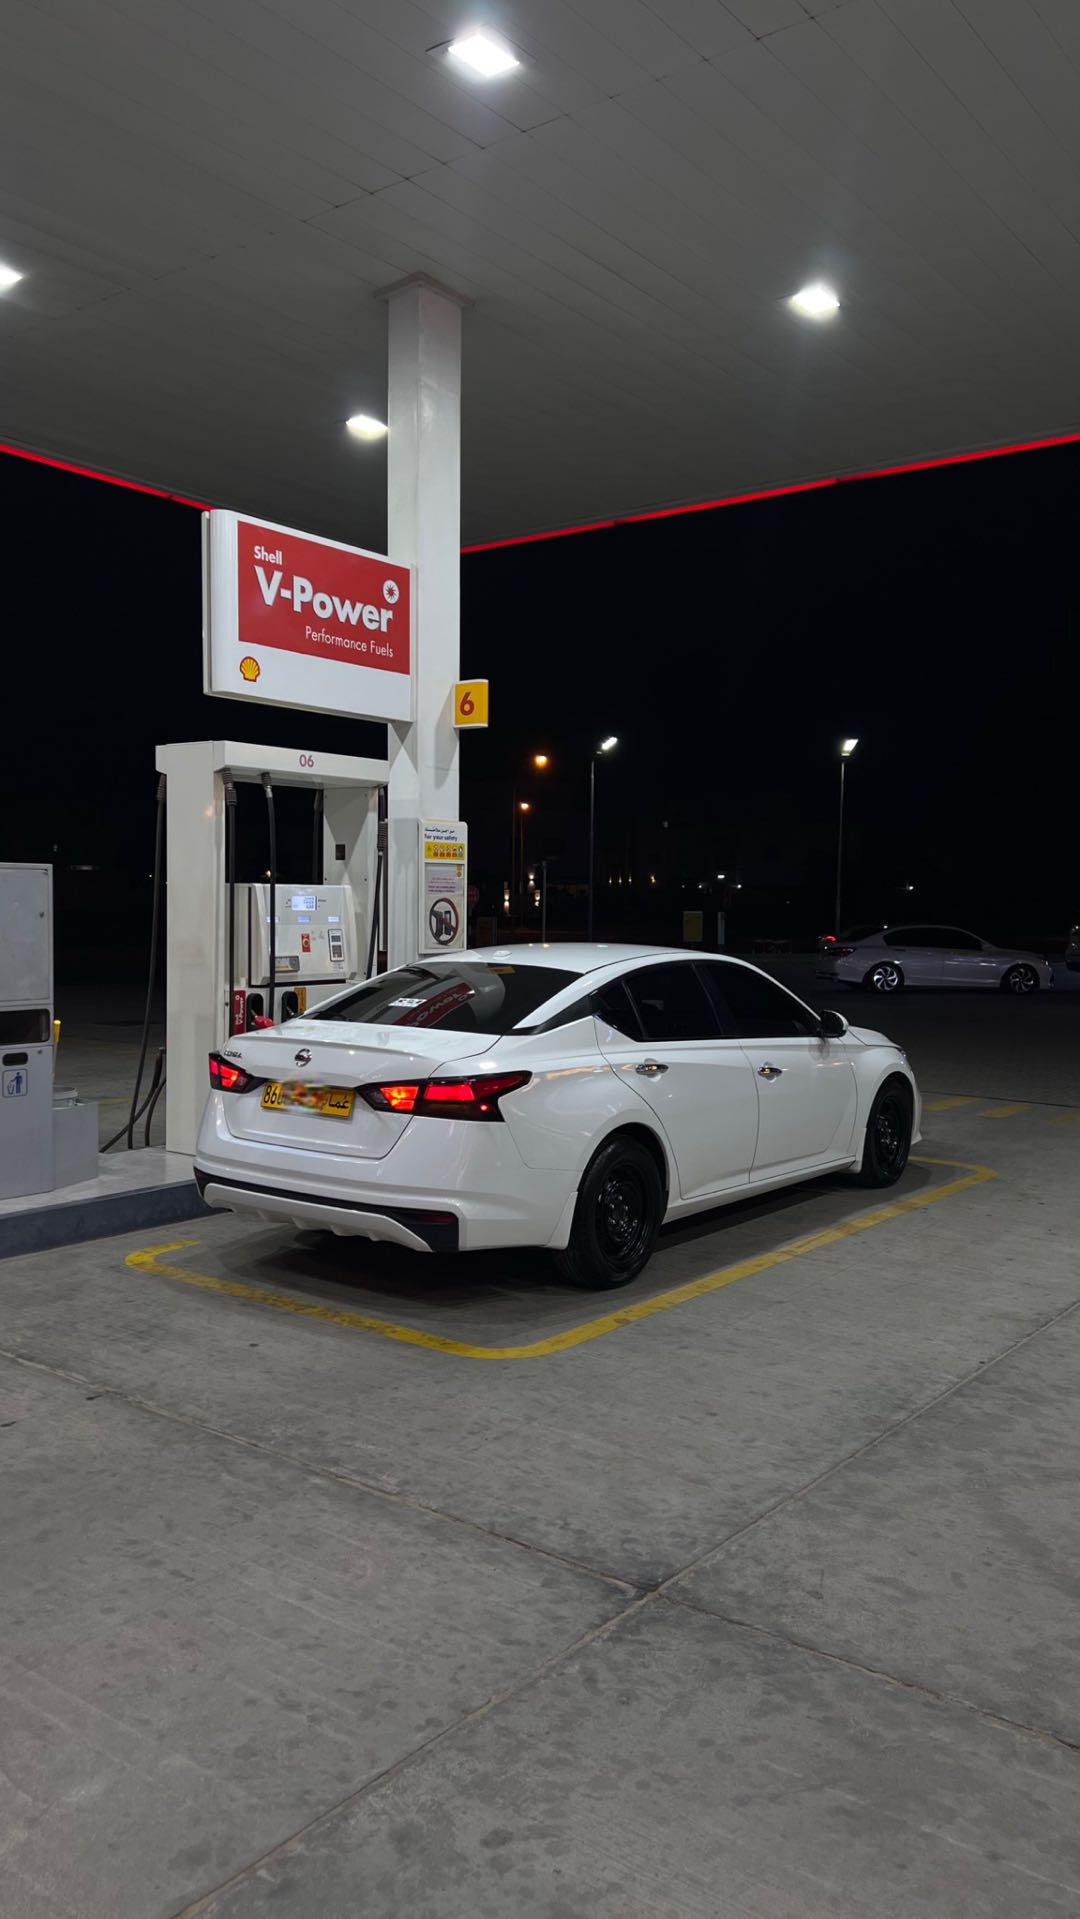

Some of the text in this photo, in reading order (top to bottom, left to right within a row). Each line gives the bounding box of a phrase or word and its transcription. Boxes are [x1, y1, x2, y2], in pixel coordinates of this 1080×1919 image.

[254, 546, 283, 565] Shell
[254, 565, 393, 633] V-Power
[305, 626, 394, 658] Performance Fuels
[459, 692, 475, 716] 6
[299, 754, 315, 768] 06
